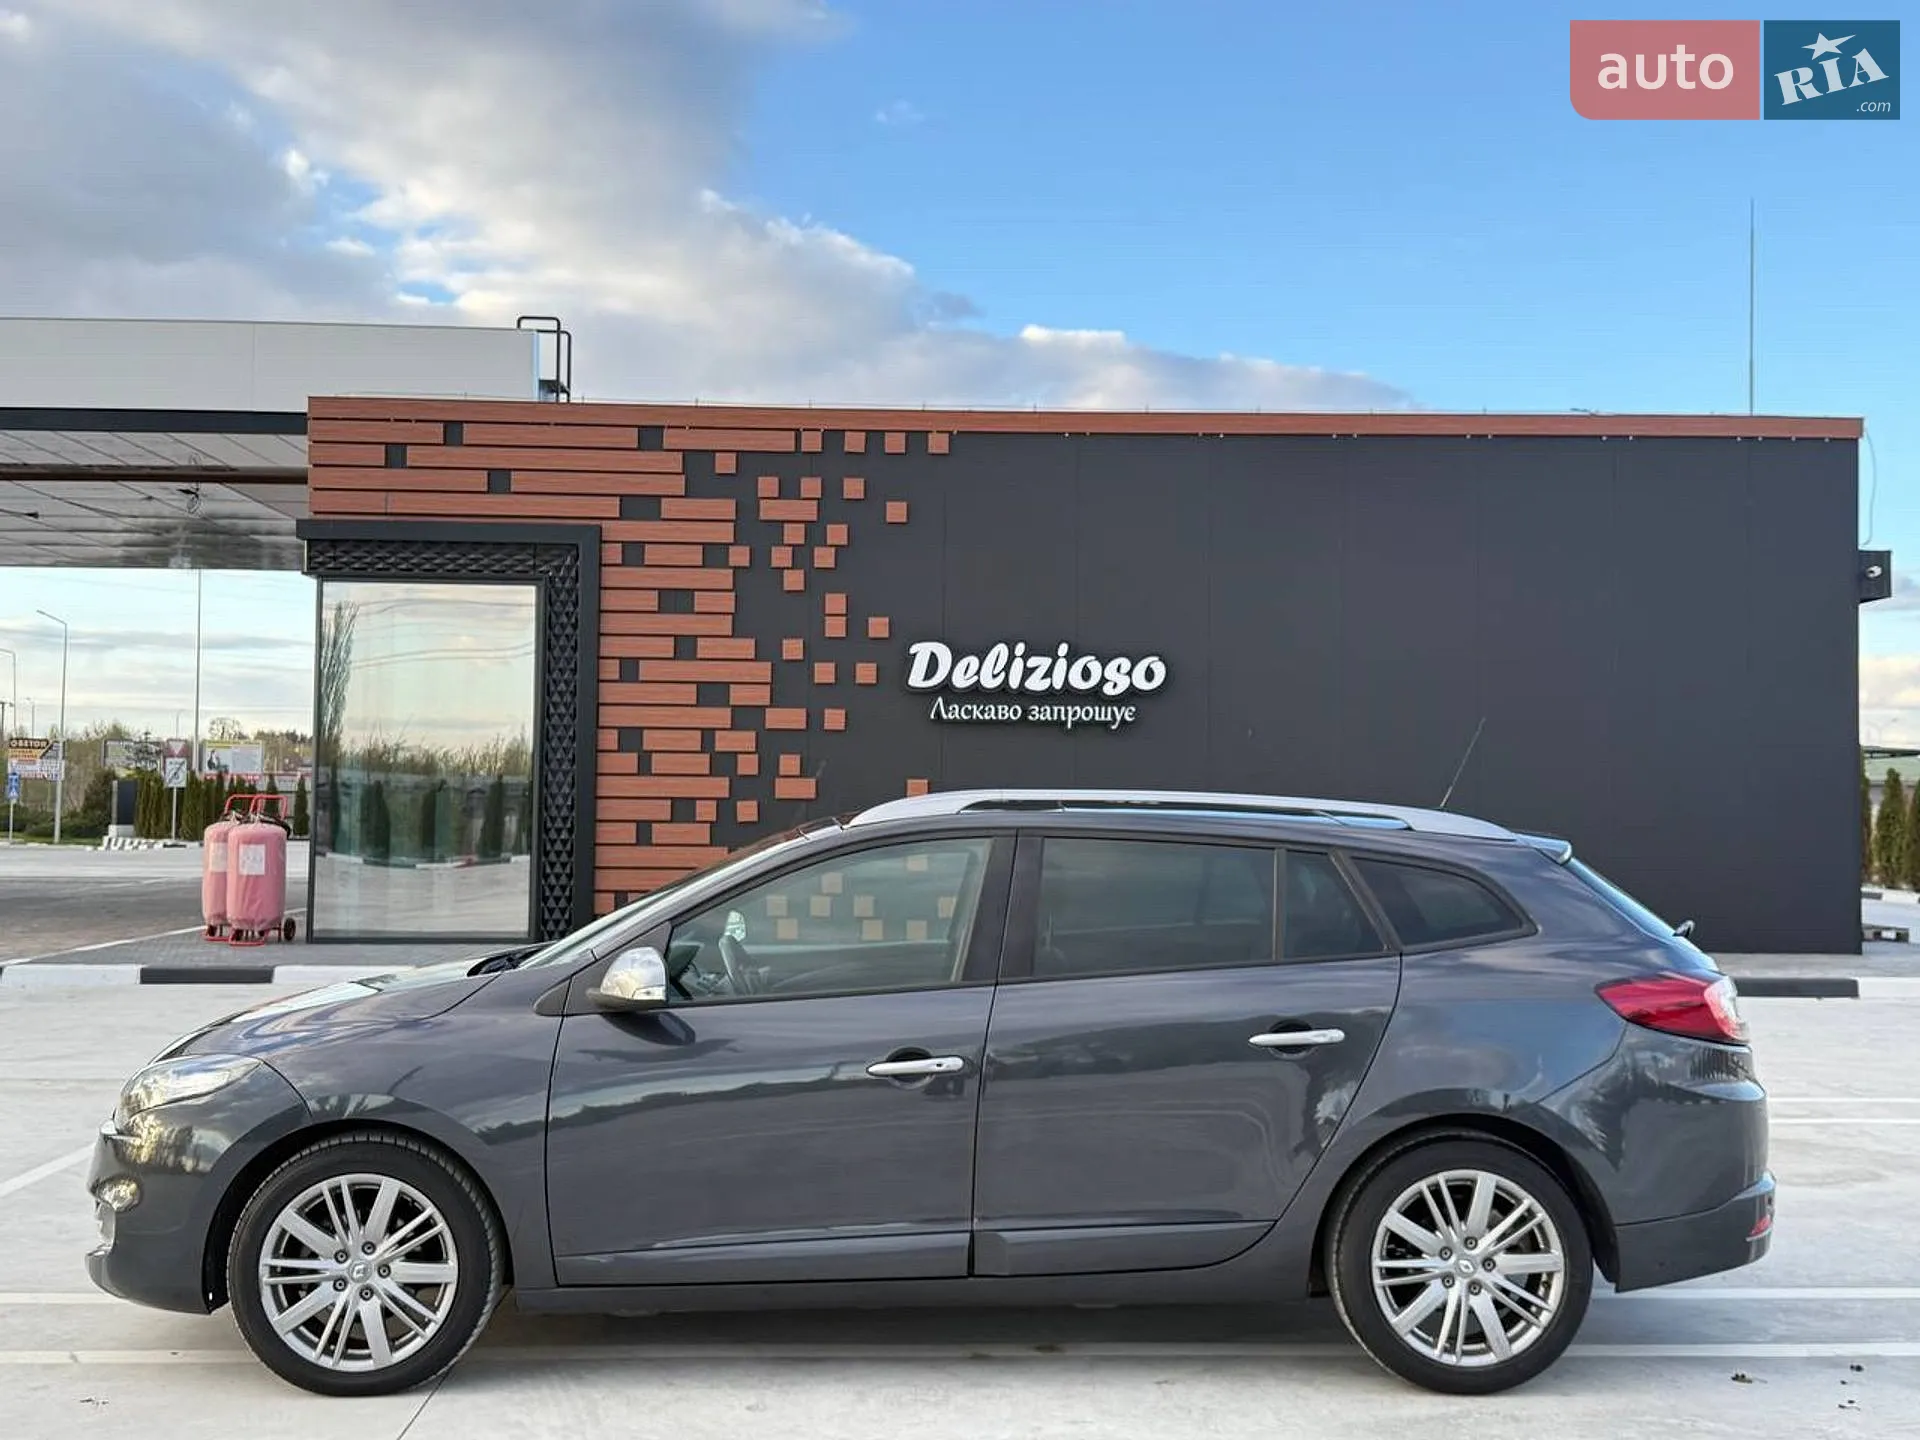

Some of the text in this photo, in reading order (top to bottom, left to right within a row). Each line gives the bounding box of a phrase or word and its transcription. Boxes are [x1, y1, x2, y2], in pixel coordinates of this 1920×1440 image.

[907, 641, 1167, 696] Delizioso
[930, 696, 1137, 730] Ласкаво запрошує
